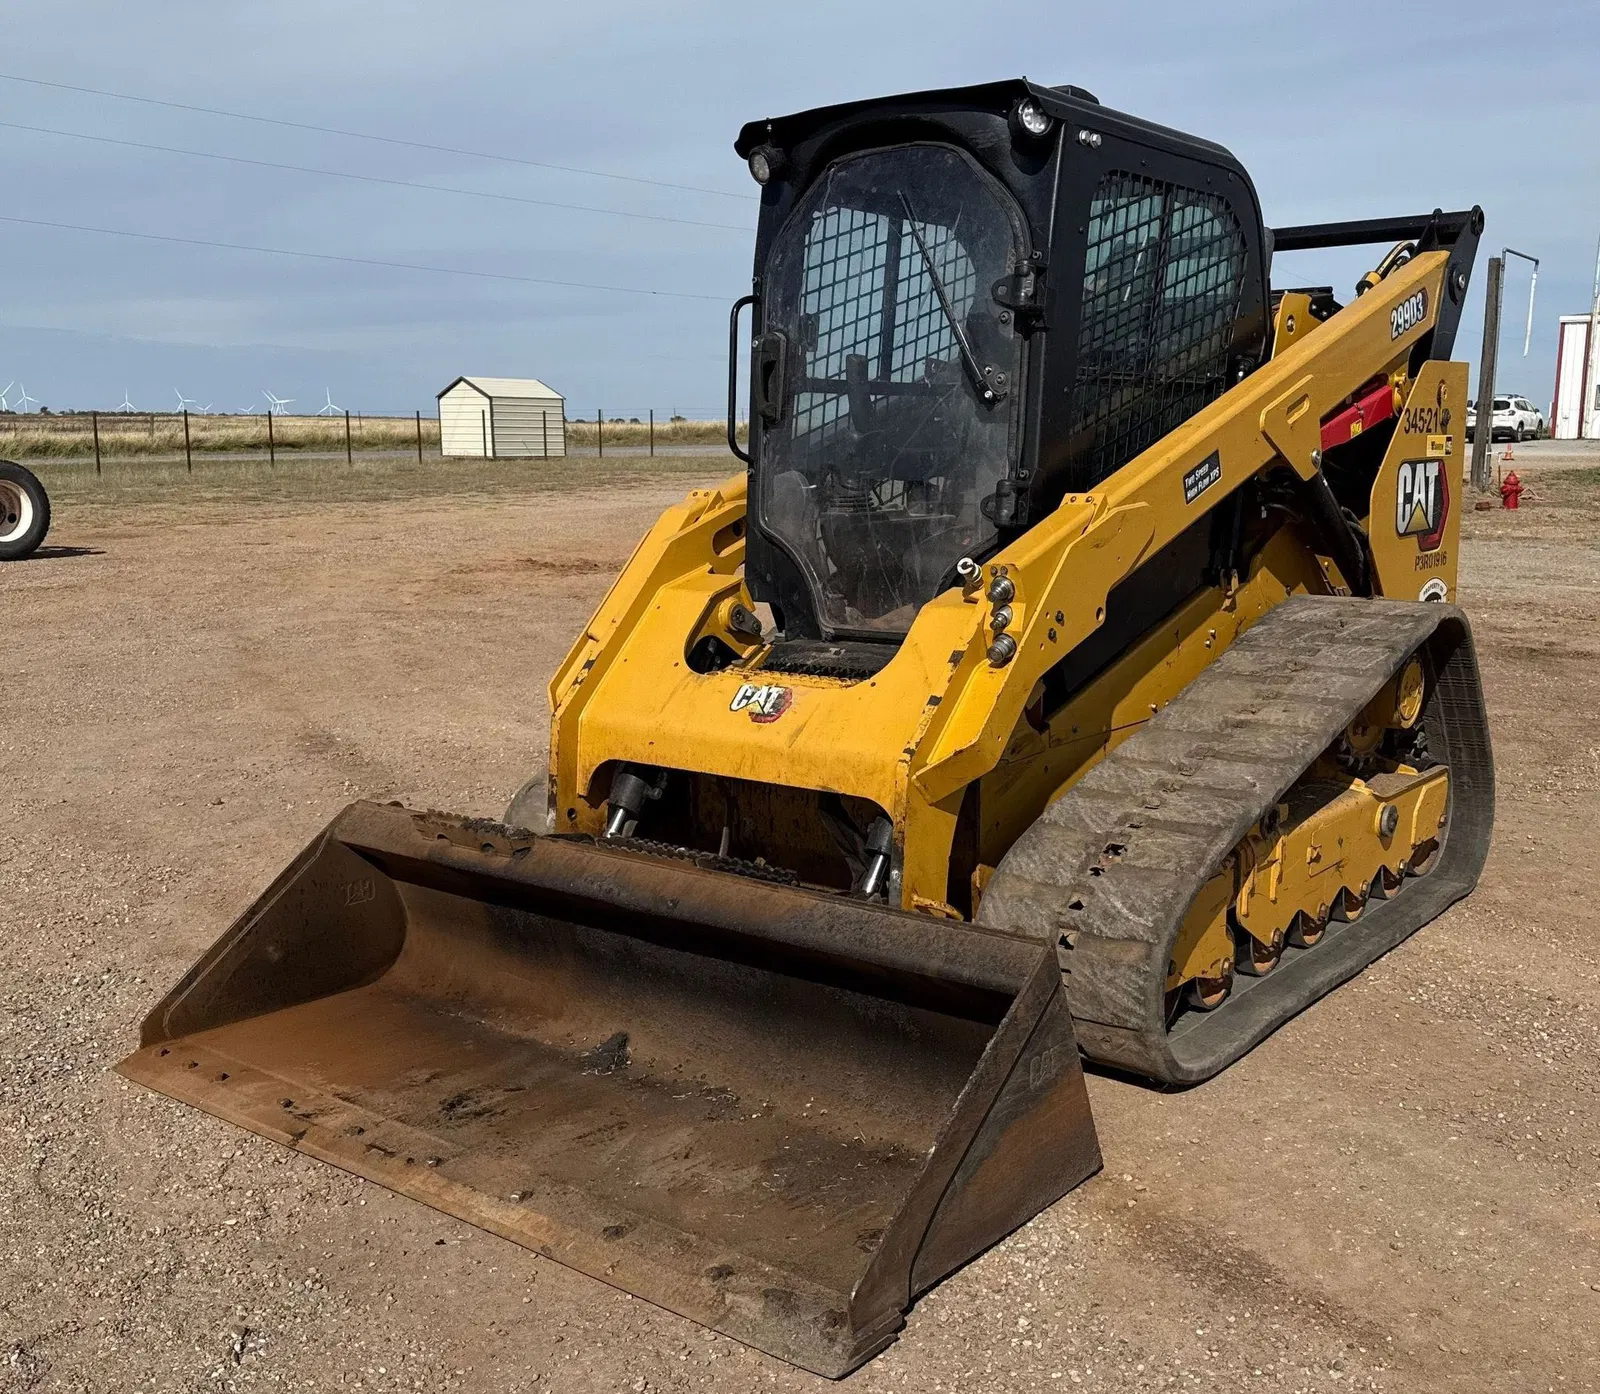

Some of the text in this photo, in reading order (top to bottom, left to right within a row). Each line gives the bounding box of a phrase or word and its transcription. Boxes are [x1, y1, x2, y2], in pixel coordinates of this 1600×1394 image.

[1391, 291, 1424, 339] 299D3
[1397, 461, 1439, 534] CAT
[730, 683, 786, 715] CAT
